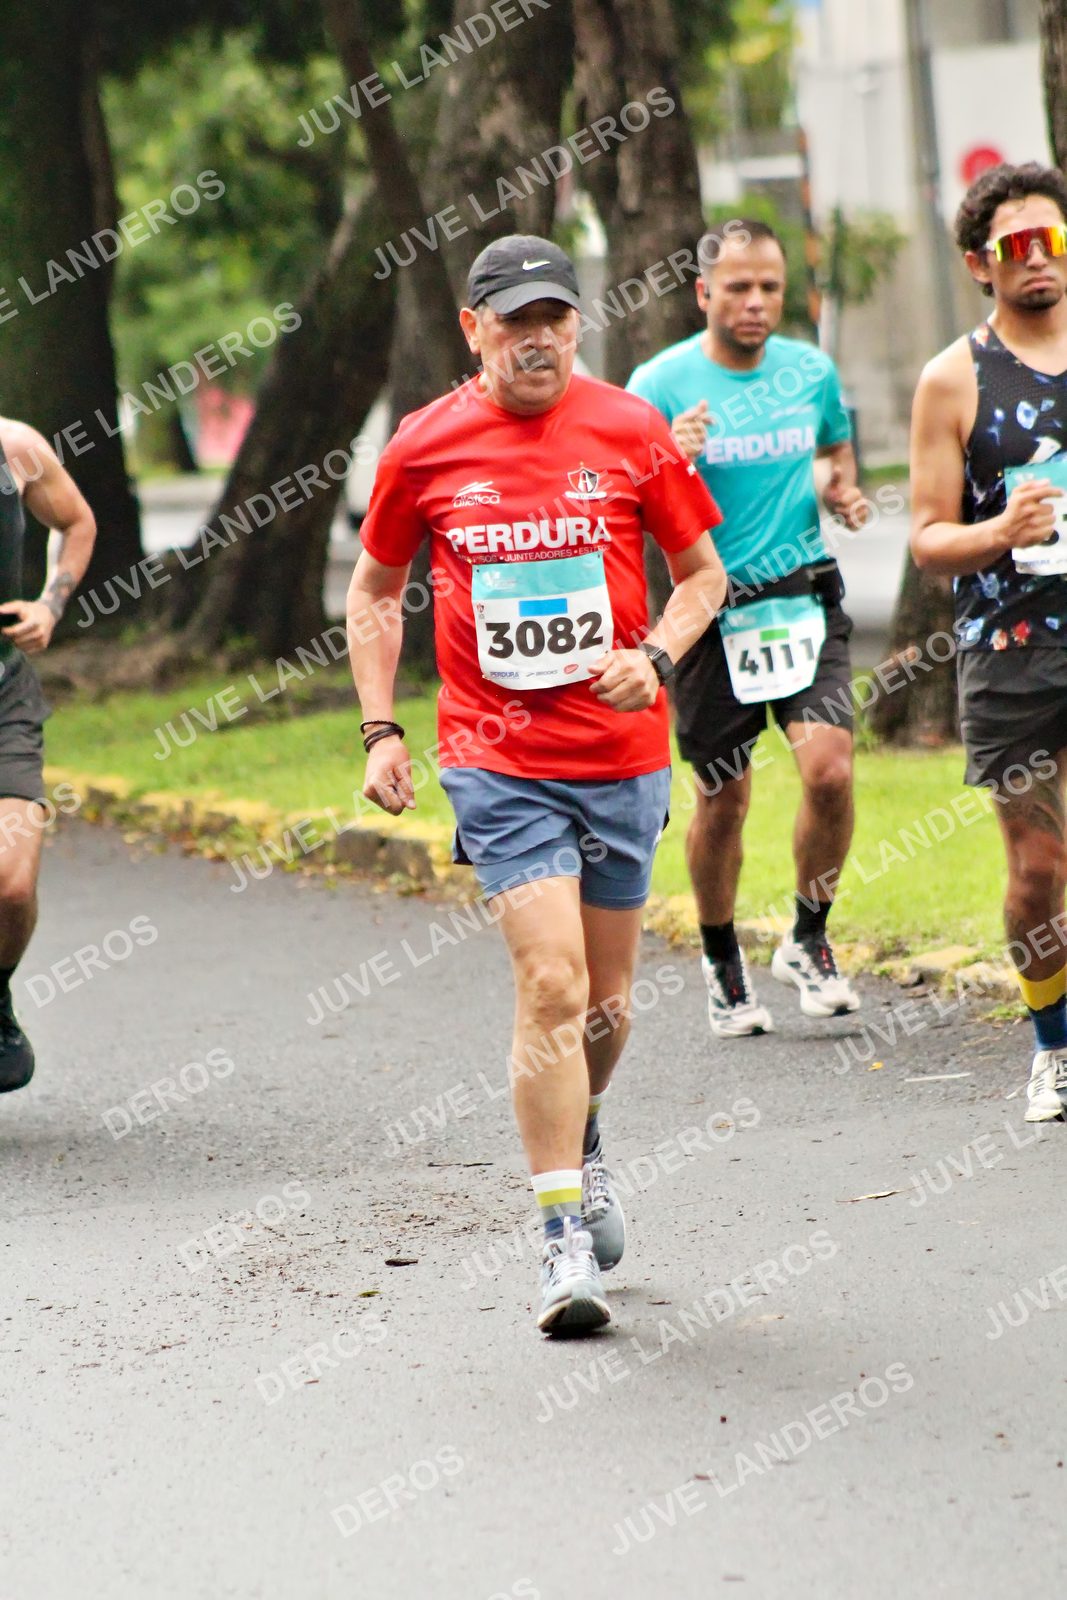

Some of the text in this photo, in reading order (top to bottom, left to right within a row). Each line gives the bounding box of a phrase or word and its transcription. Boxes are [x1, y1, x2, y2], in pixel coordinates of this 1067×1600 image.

[704, 425, 816, 464] ERDURA
[446, 516, 612, 554] PERDURA
[504, 549, 573, 562] JUNTEADORES
[485, 611, 604, 659] 3082
[738, 637, 815, 676] 4111
